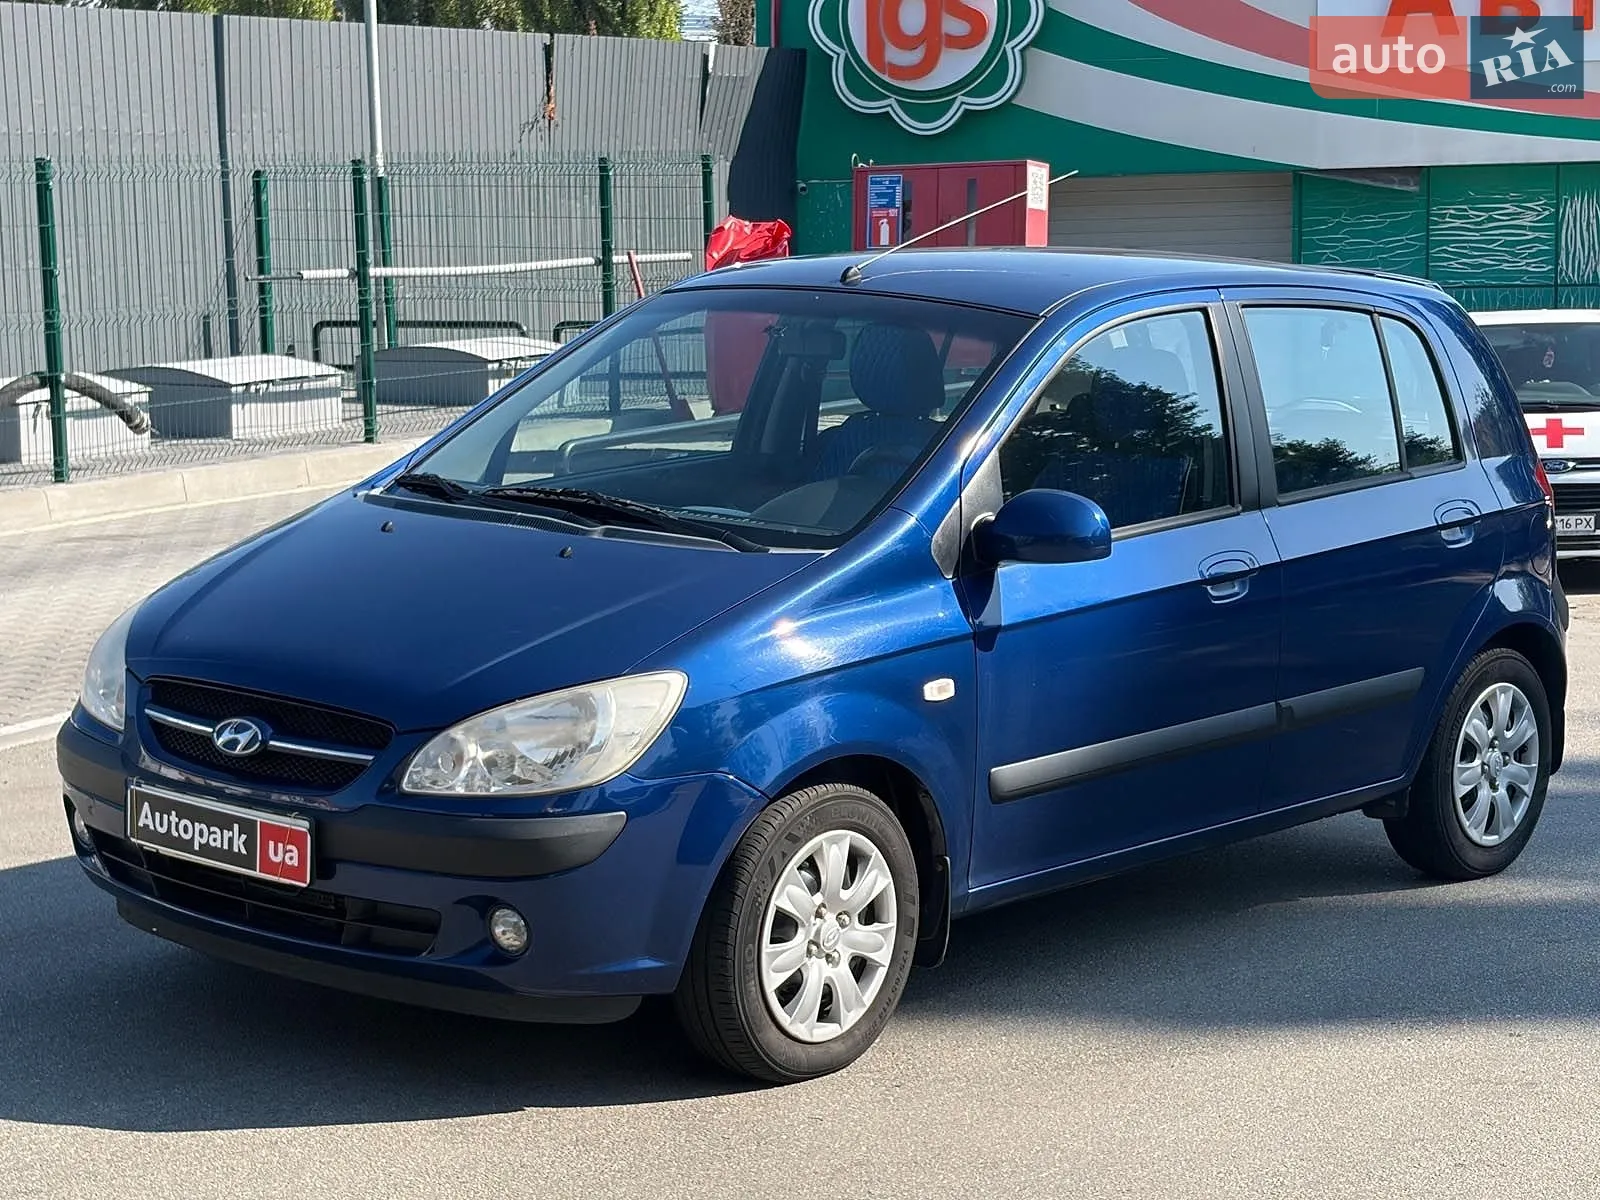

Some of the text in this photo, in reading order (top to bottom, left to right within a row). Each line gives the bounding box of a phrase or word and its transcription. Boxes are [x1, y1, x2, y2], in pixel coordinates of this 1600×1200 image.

[1555, 518, 1572, 529] 16
[138, 801, 298, 867] Autopark ua
